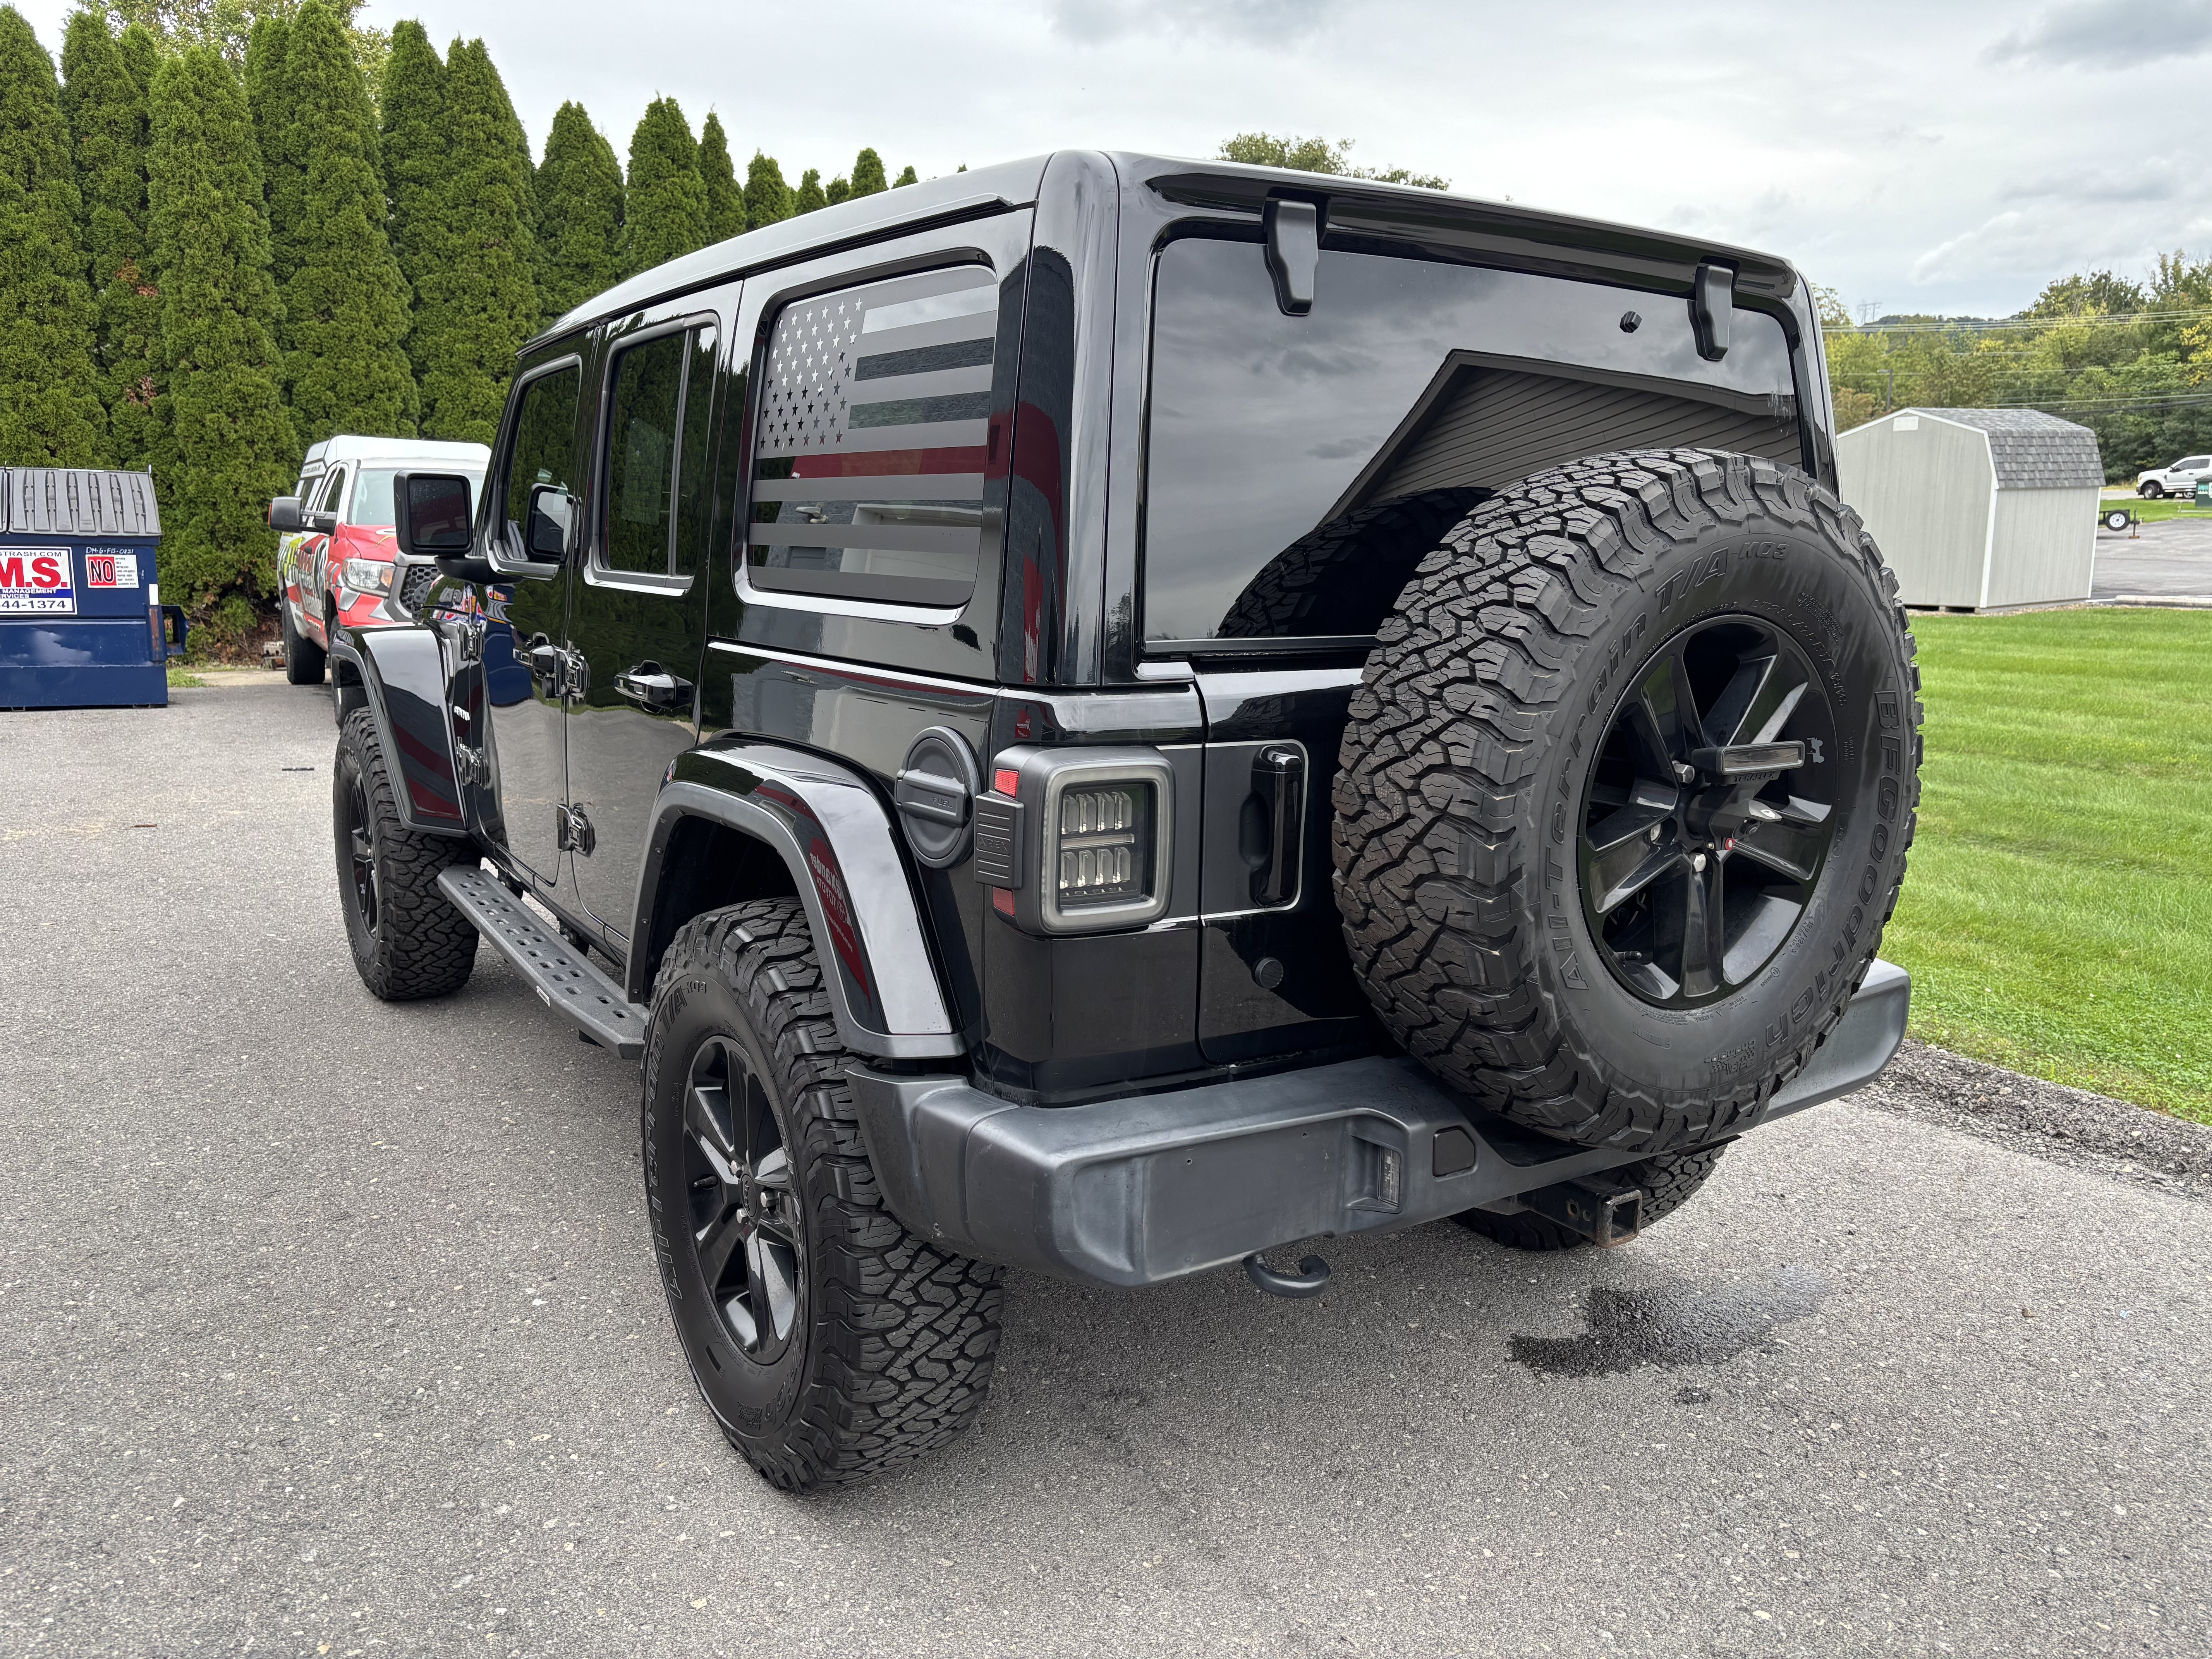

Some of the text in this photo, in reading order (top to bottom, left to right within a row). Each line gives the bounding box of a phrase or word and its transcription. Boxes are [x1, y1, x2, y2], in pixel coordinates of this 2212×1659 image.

[89, 559, 115, 583] NO
[0, 600, 66, 609] 44-1374
[1546, 612, 1647, 990] All-Terrain
[1655, 547, 1729, 615] T/A
[1738, 541, 1790, 560] KO3
[1735, 772, 1776, 782] TERAFLEX
[933, 797, 952, 808] FUEL
[1765, 690, 1901, 1046] BFGoodrich
[659, 985, 688, 1034] T/A
